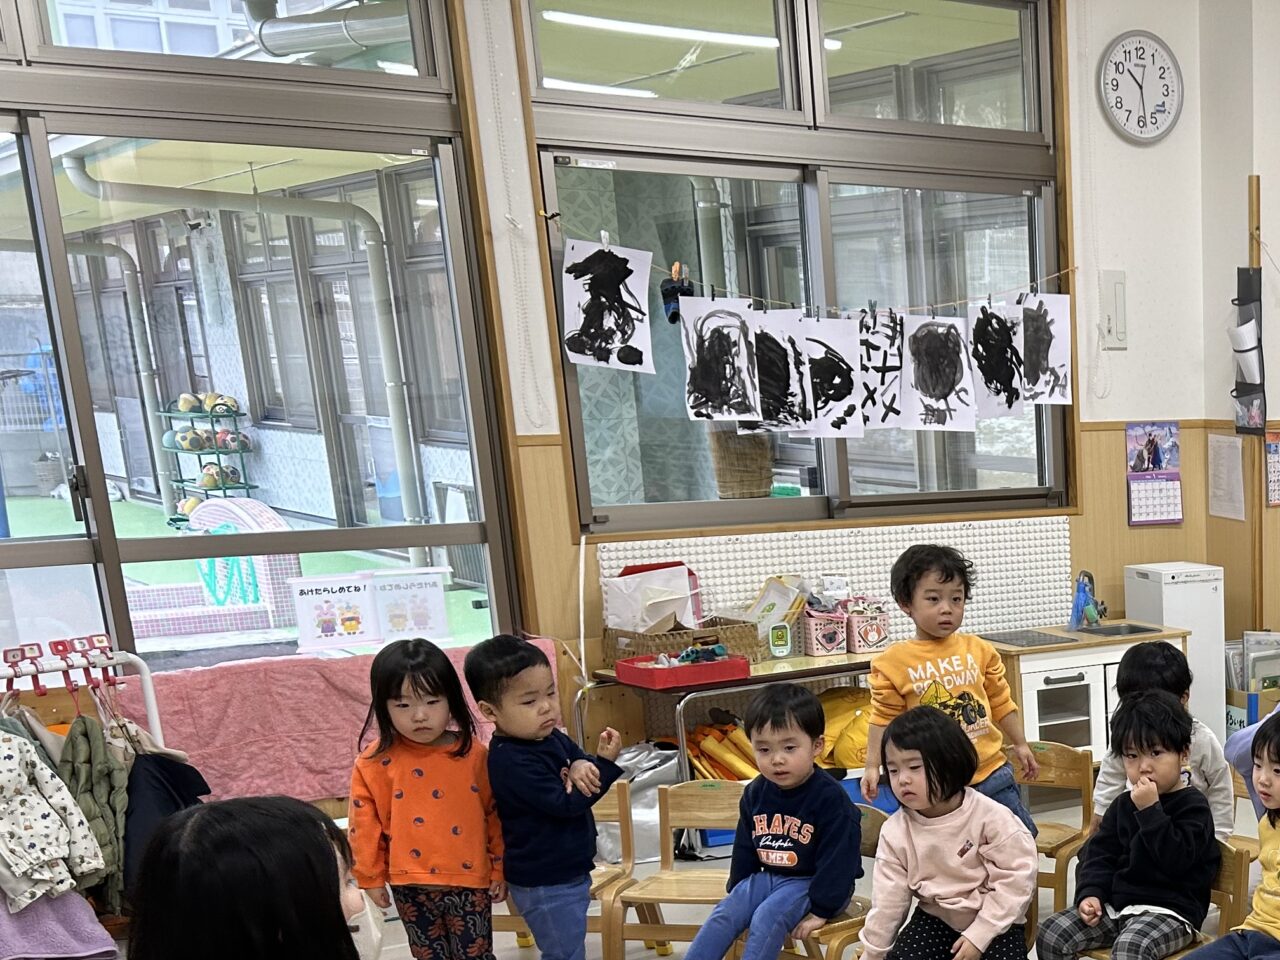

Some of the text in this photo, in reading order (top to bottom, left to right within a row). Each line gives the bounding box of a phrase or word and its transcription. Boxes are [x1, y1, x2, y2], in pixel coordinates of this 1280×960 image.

[1123, 50, 1131, 63] 11
[1135, 46, 1146, 60] 12
[1151, 53, 1155, 65] 1
[1114, 61, 1125, 75] 10
[1159, 66, 1166, 79] 2
[1111, 78, 1119, 91] 9
[1162, 84, 1170, 97] 3
[1115, 96, 1123, 110] 8
[1125, 109, 1132, 123] 7
[1137, 115, 1145, 128] 6
[1150, 111, 1158, 126] 5
[907, 653, 977, 682] MAKE A
